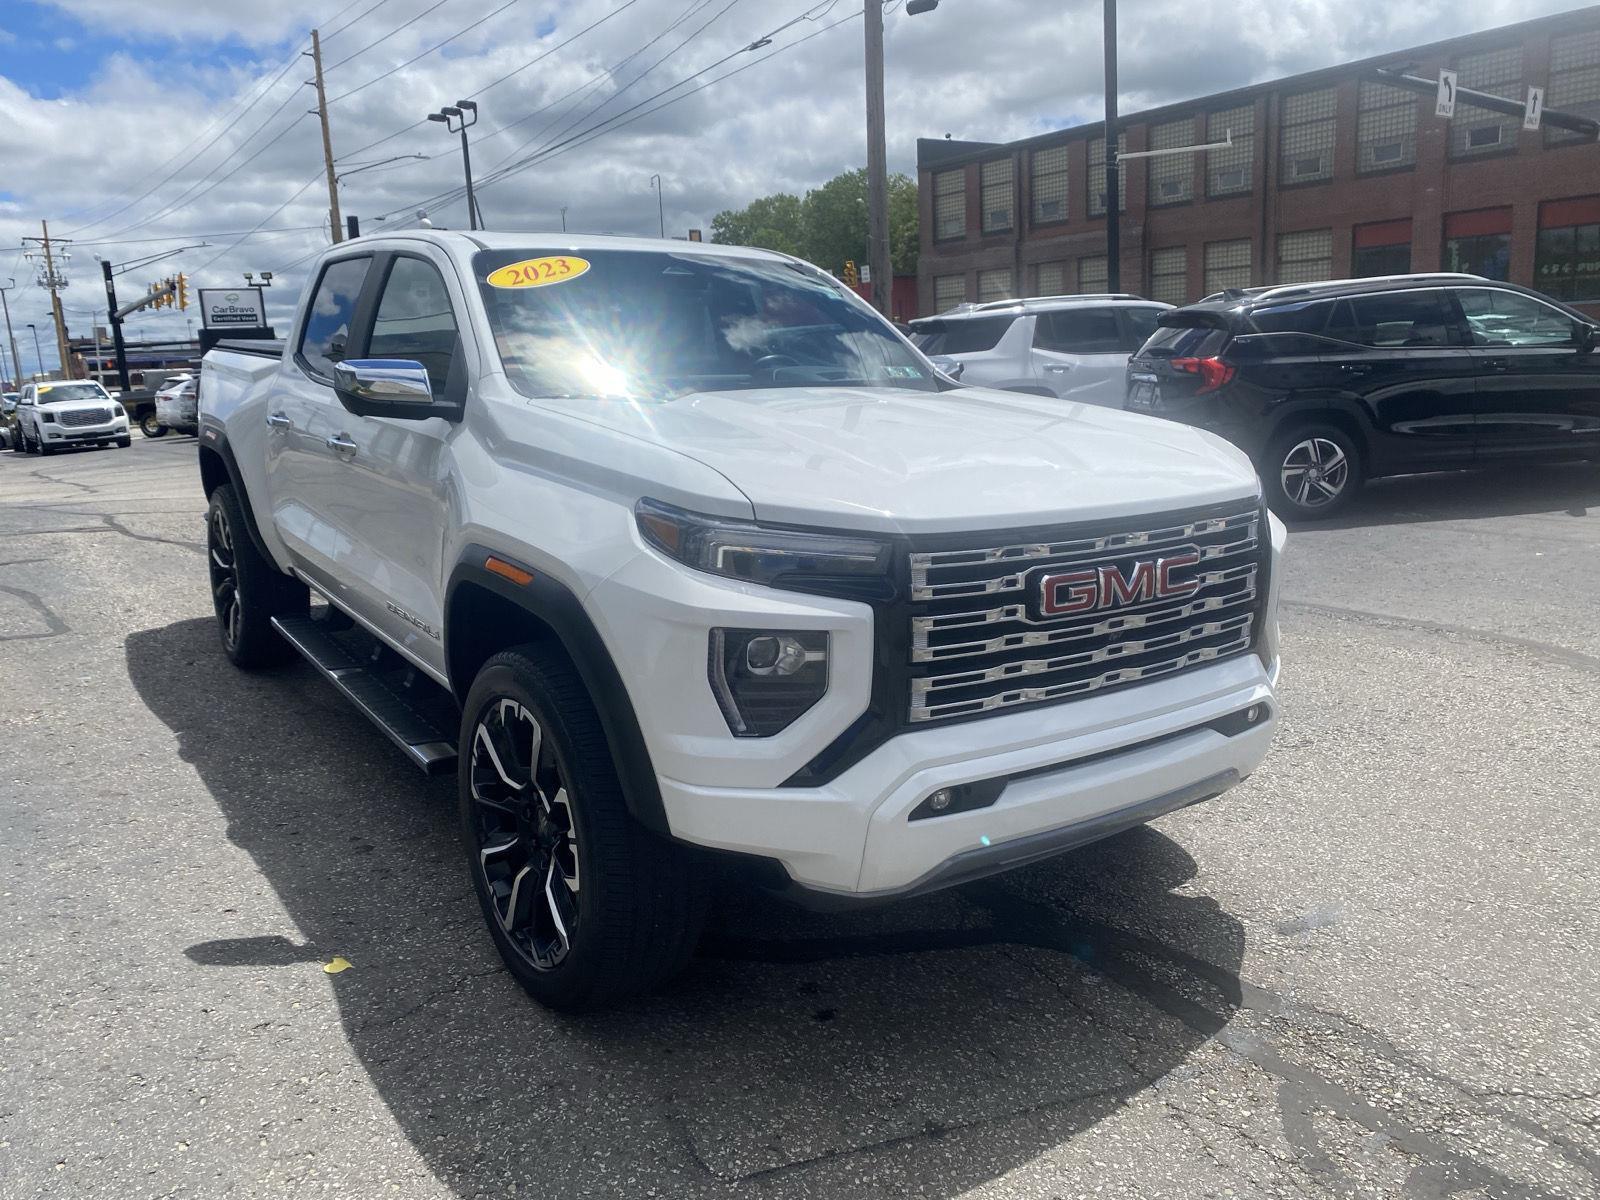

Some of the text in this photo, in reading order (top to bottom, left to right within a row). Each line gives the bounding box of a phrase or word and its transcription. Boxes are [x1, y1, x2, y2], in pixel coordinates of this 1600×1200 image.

[1438, 103, 1452, 114] ONLY
[506, 259, 571, 285] 2023
[212, 305, 255, 313] CarBravo
[1040, 552, 1200, 616] GMC
[386, 600, 440, 640] DENALI
